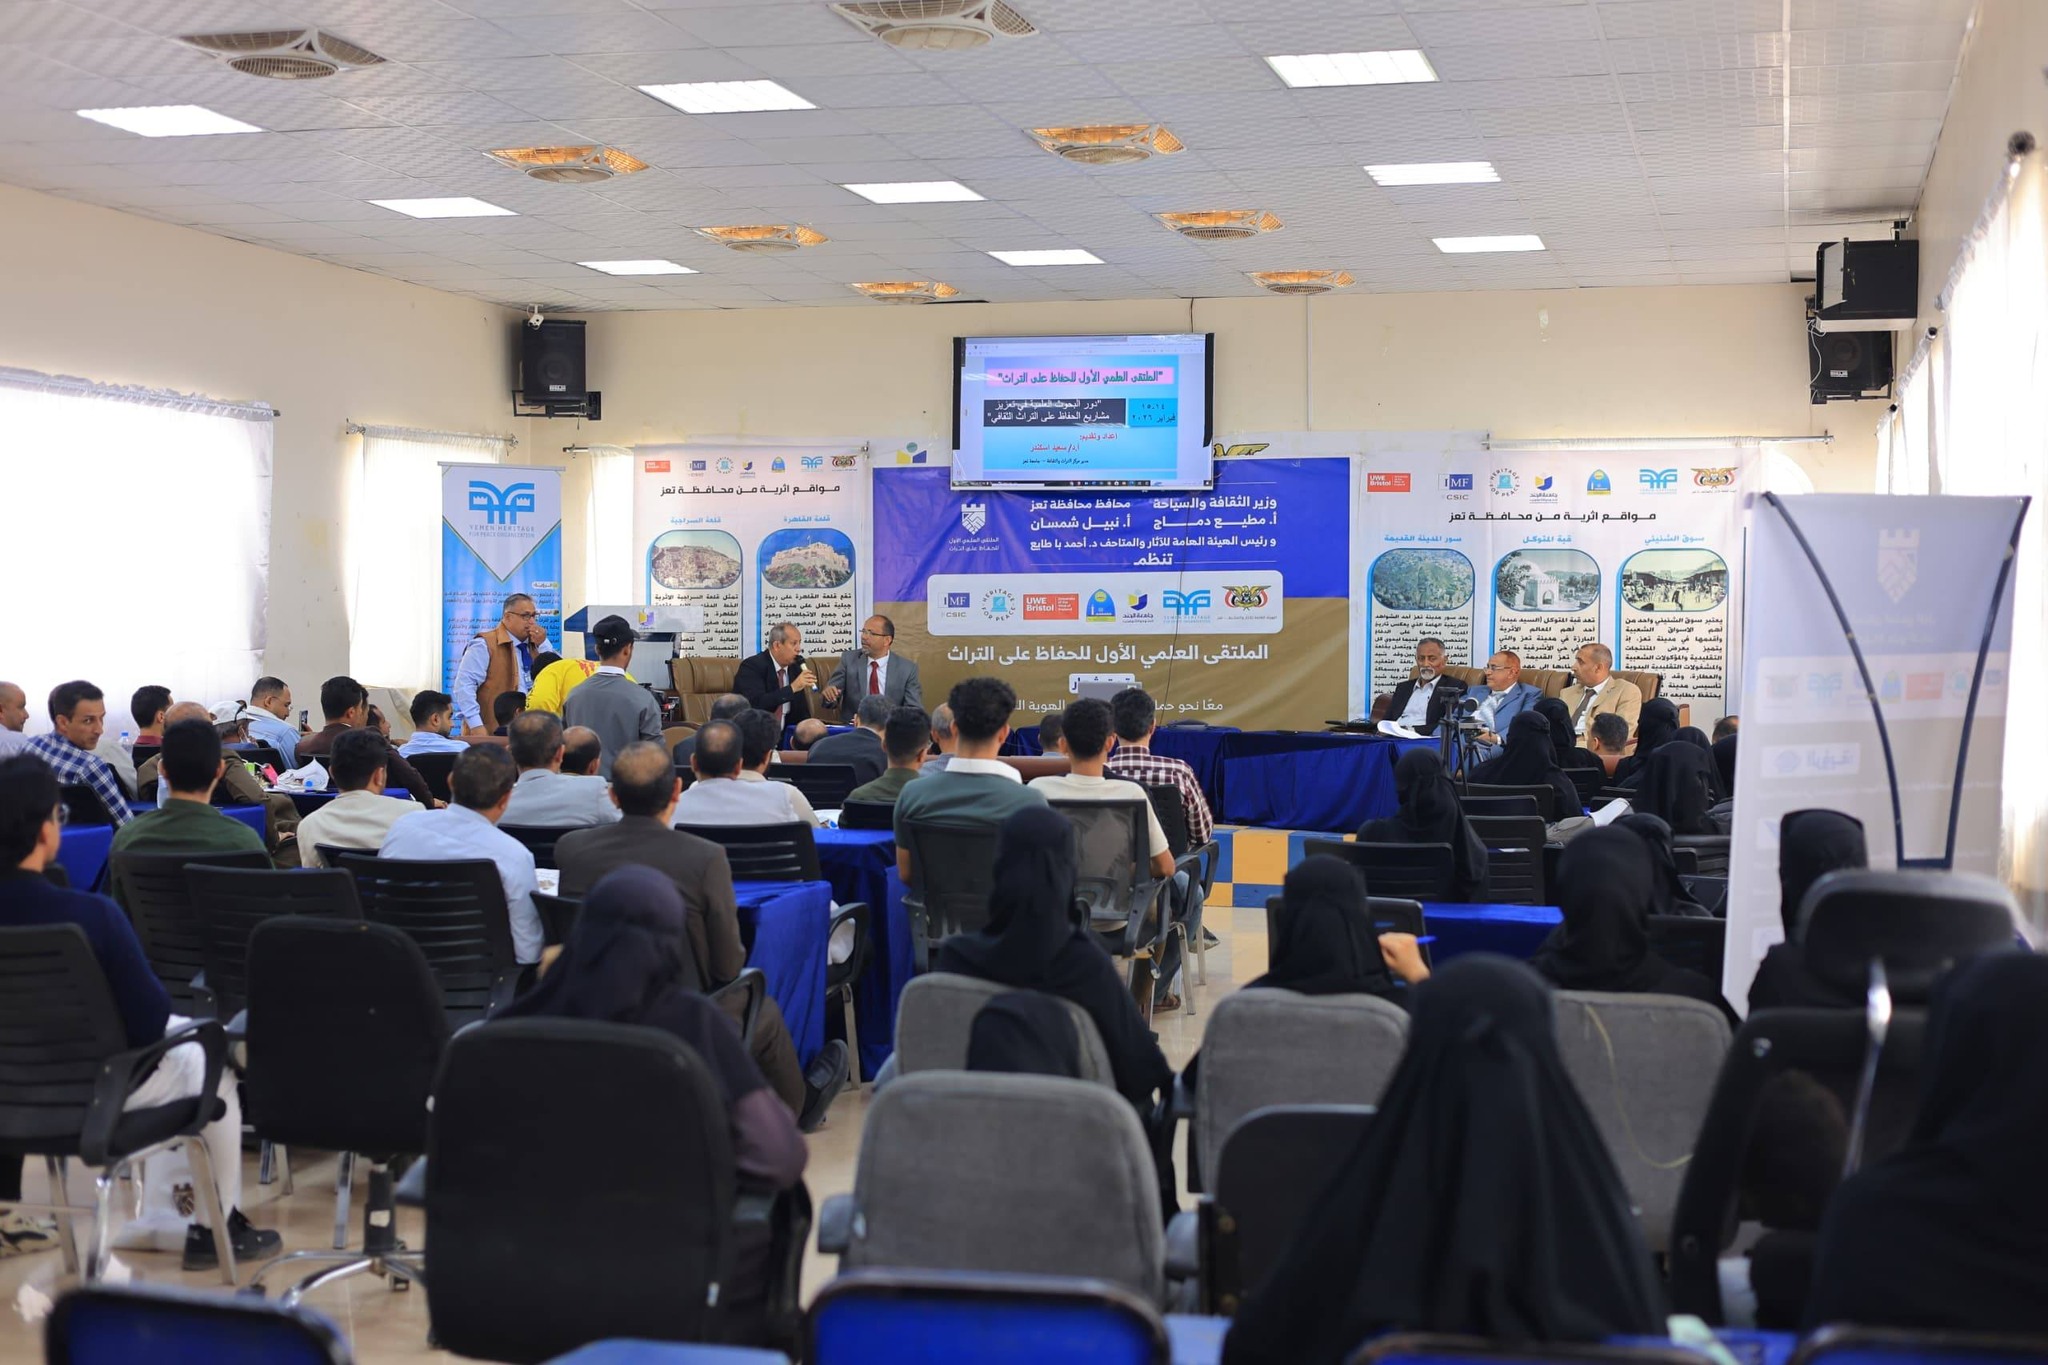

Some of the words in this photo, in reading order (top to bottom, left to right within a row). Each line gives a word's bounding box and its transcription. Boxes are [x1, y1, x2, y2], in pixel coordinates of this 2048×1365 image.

[1031, 374, 1048, 383] على
[1050, 372, 1076, 383] للحفاظ
[1079, 370, 1099, 384] الأول
[1103, 372, 1127, 384] العلمي
[1016, 411, 1038, 422] التراث
[1041, 412, 1055, 422] على
[1083, 411, 1109, 424] مشاريع
[660, 486, 676, 496] تعز
[678, 485, 734, 494] محافظة
[736, 486, 757, 495] من
[793, 484, 840, 495] مواقع
[1030, 500, 1047, 512] تعز
[1050, 499, 1092, 510] محافظة
[1095, 499, 1130, 510] محافظ
[1153, 496, 1206, 512] والسياحة
[1209, 495, 1250, 509] الثقافة
[1253, 497, 1277, 511] وزير
[1123, 514, 1131, 528] أ.
[1270, 512, 1277, 525] أ.
[1448, 512, 1466, 523] تعز
[1468, 512, 1532, 521] محافظة
[1535, 512, 1560, 522] من
[1564, 510, 1598, 522] اثرية
[1602, 512, 1656, 522] مواقع
[1064, 539, 1087, 549] أحمد
[1100, 539, 1145, 550] والمتاحف
[1207, 535, 1237, 546] الهيئة
[1240, 537, 1267, 548] رئيس
[1681, 636, 1689, 644] في
[947, 645, 994, 664] التراث
[998, 648, 1031, 665] على
[1035, 645, 1090, 661] للحفاظ
[1095, 642, 1136, 664] الأول
[1141, 645, 1198, 668] العلمي
[1204, 644, 1268, 664] الملتقى
[1626, 654, 1654, 662] الشعبية
[1029, 700, 1065, 712] الهوية
[1179, 701, 1200, 712] نحو
